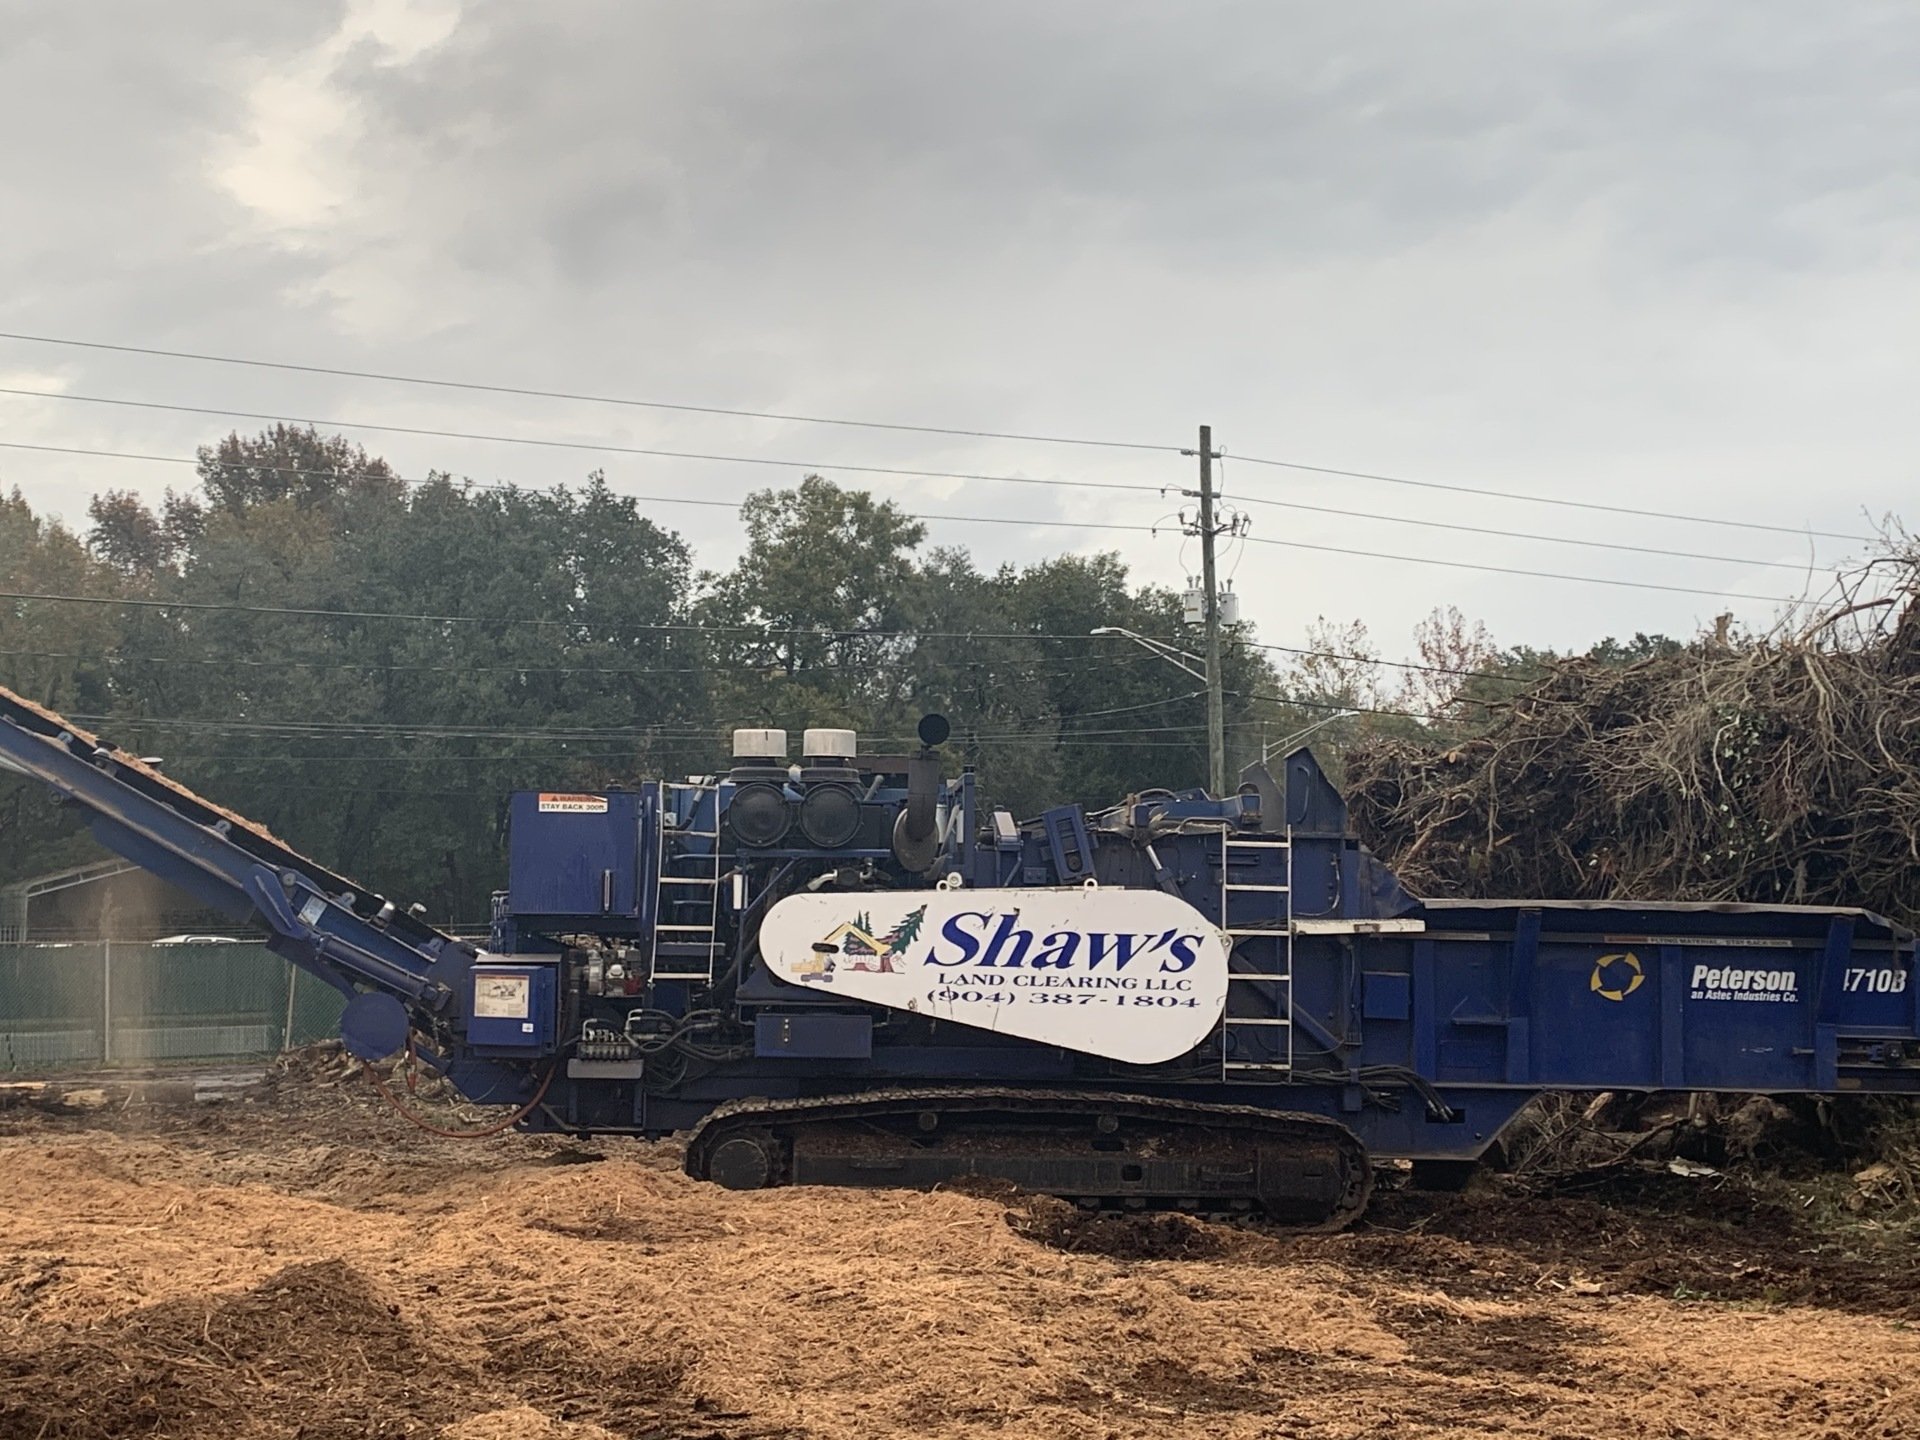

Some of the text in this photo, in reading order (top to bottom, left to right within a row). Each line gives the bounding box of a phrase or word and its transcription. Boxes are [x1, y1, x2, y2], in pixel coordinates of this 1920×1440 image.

[923, 911, 1205, 973] Shaw's
[938, 973, 1192, 991] LAND CLEARING LLC
[927, 990, 1200, 1008] (904) 387-1804
[1691, 990, 1799, 1003] an Astec Industries Co.
